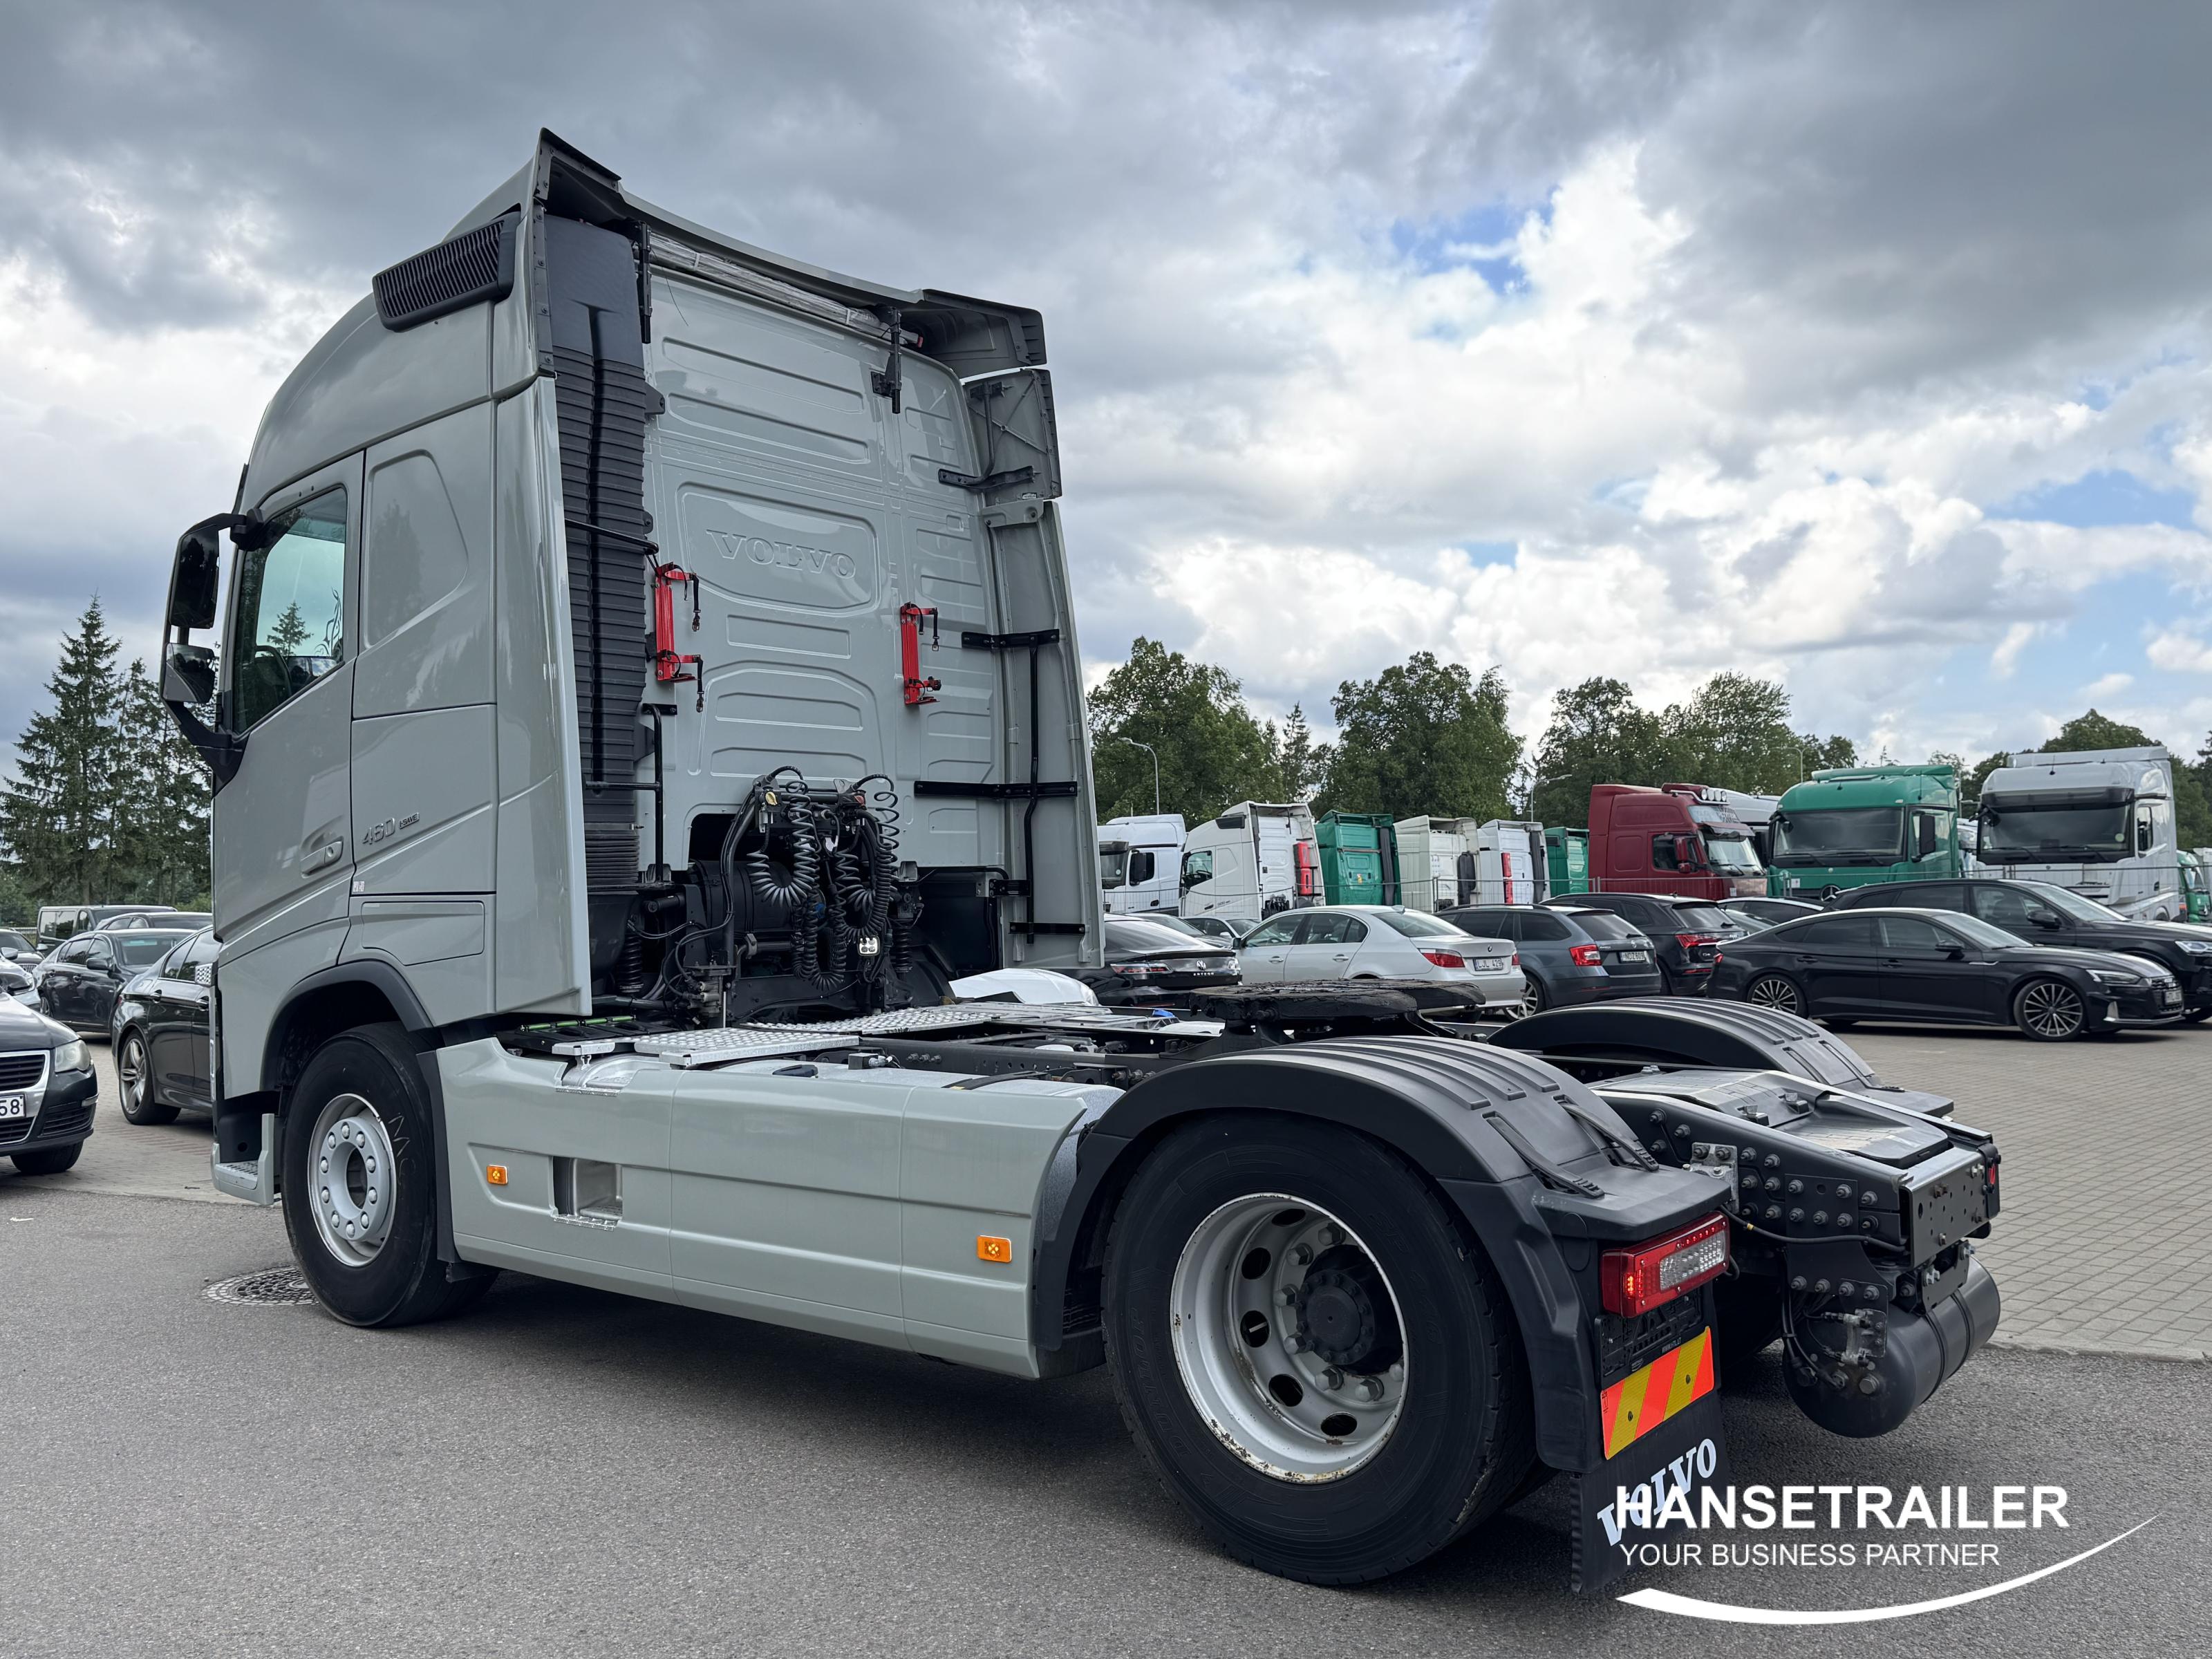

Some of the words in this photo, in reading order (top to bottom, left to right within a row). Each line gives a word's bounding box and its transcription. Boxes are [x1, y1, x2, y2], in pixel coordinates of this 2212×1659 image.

[705, 528, 856, 579] VOLVO
[362, 817, 395, 845] 460
[1597, 1438, 1716, 1546] VOLVO
